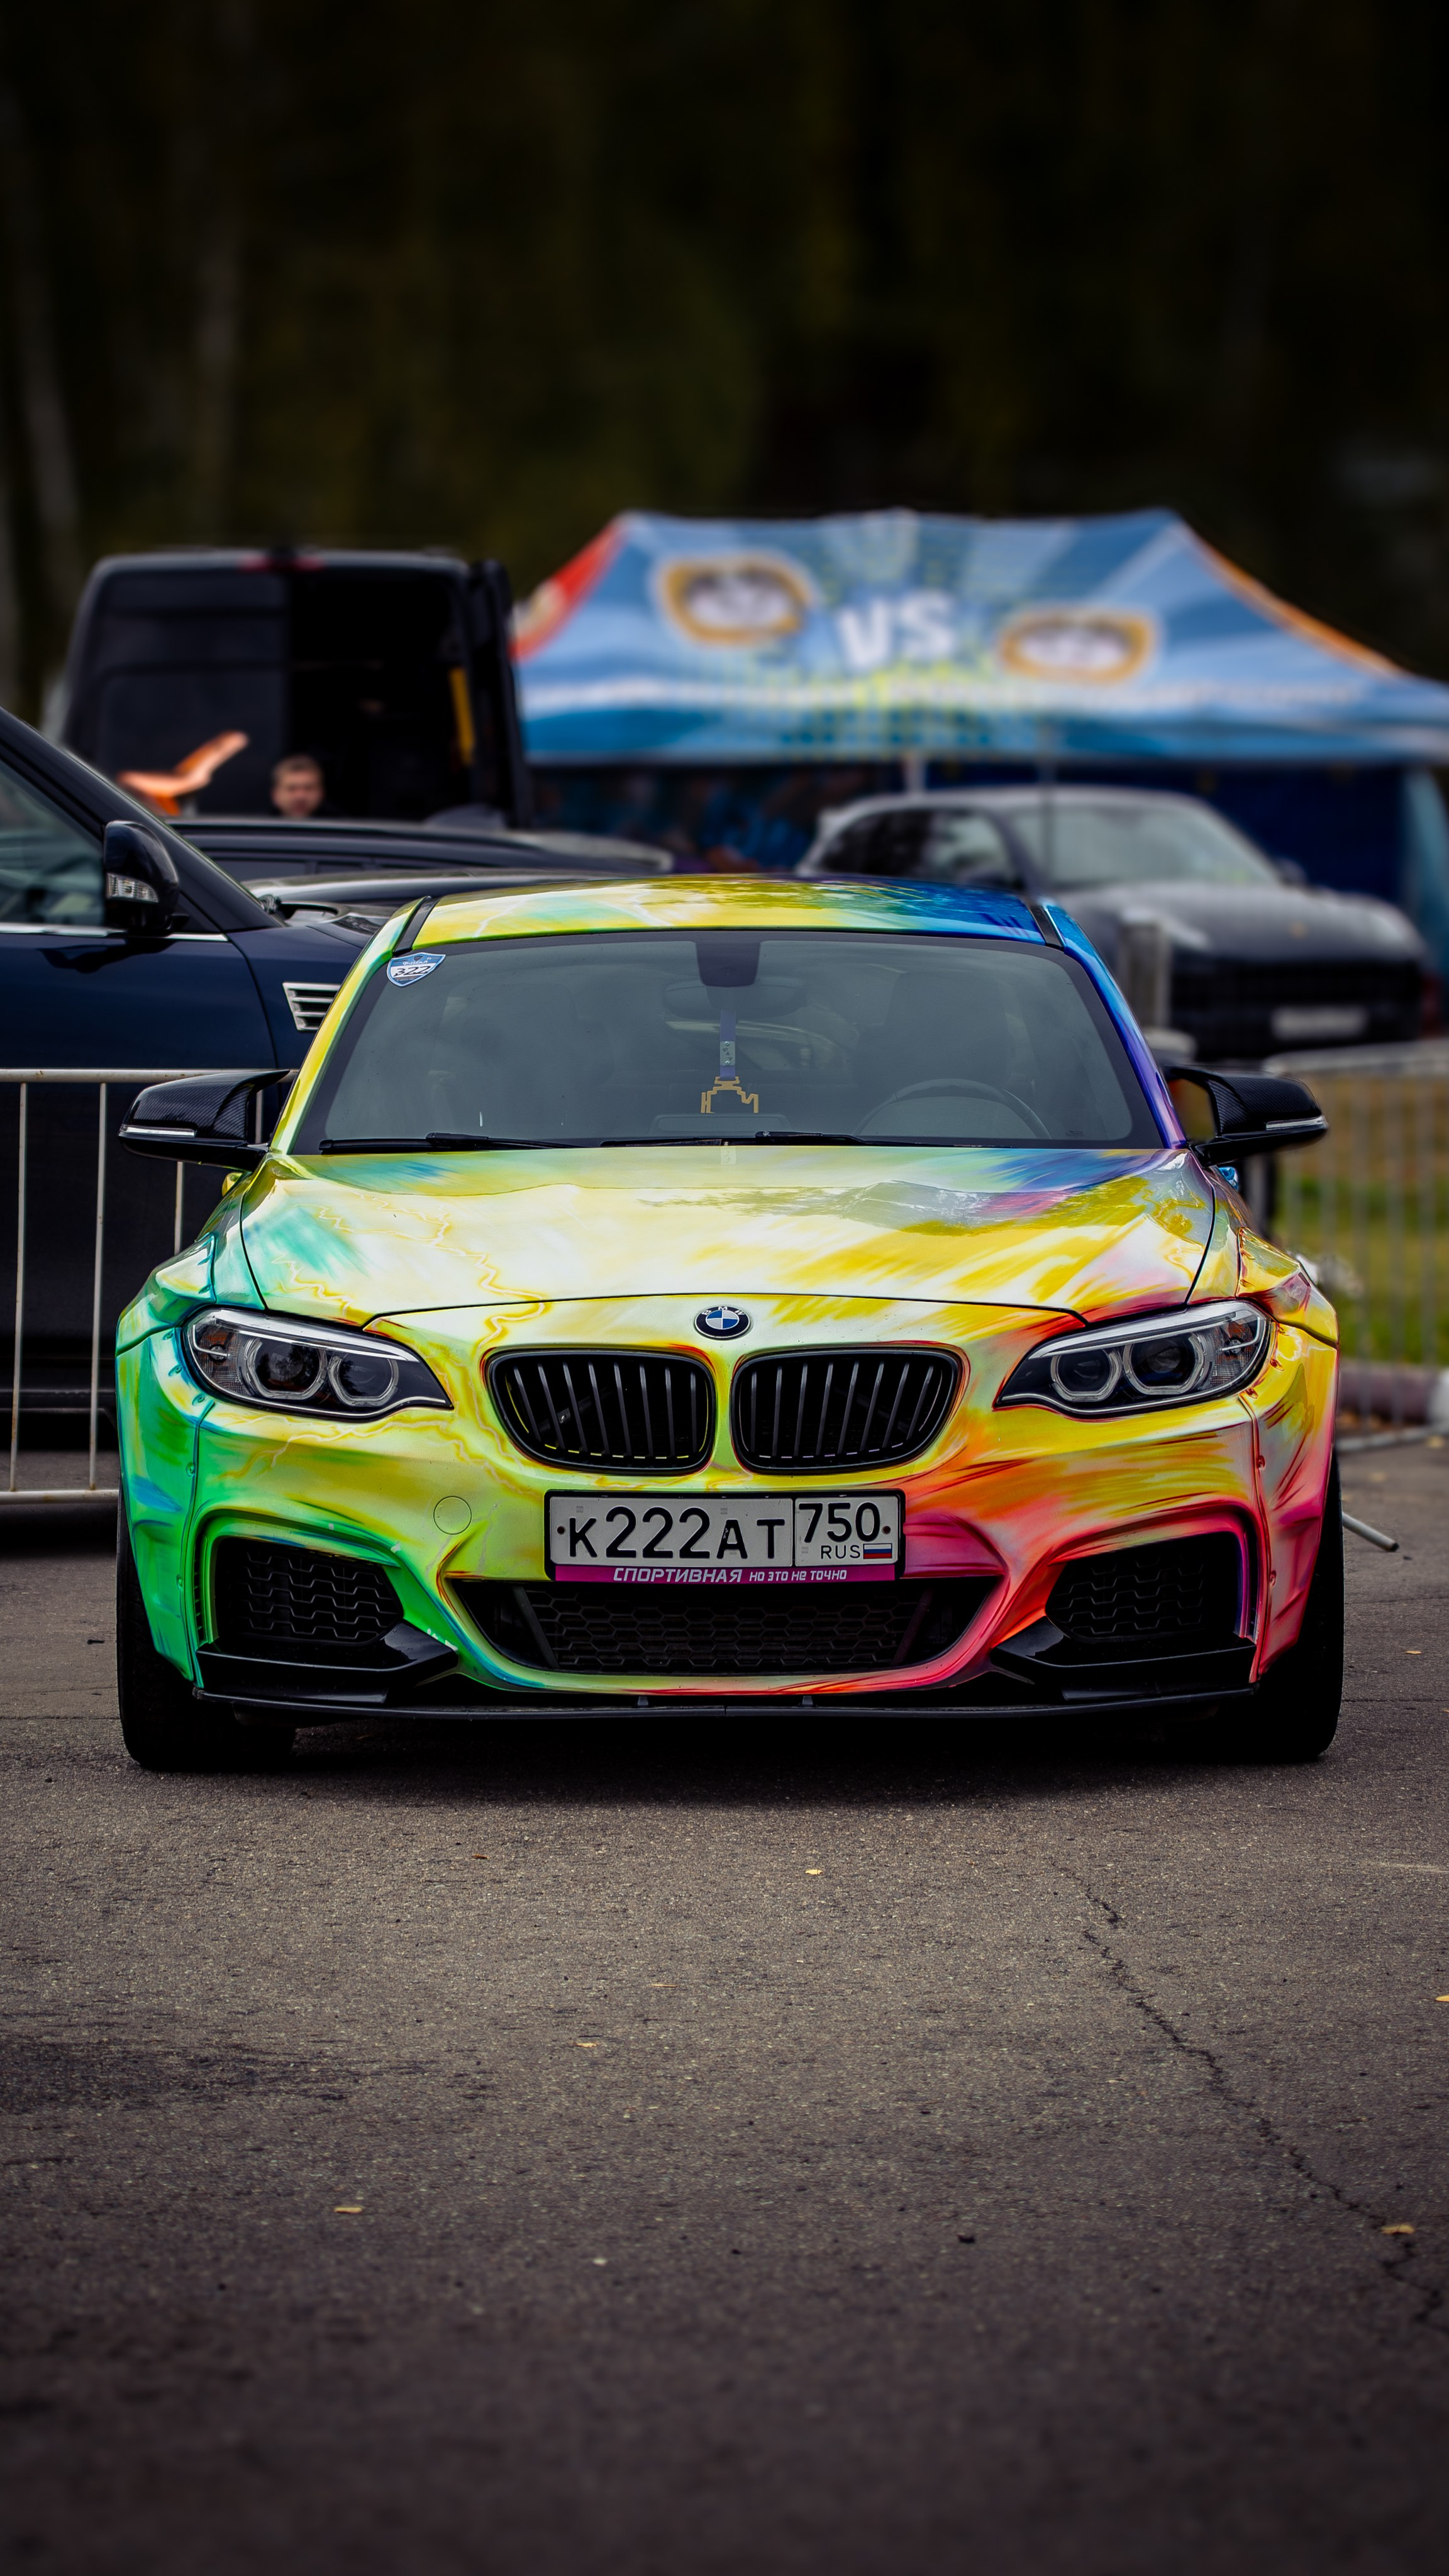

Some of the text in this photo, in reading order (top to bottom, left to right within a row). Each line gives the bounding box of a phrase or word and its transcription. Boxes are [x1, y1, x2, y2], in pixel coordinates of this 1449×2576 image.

[838, 590, 955, 669] VS
[393, 965, 431, 977] 322
[701, 1306, 745, 1316] BMW
[799, 1502, 880, 1543] 750
[820, 1544, 861, 1560] RUS
[613, 1567, 743, 1583] СПОРТИВНАЯ
